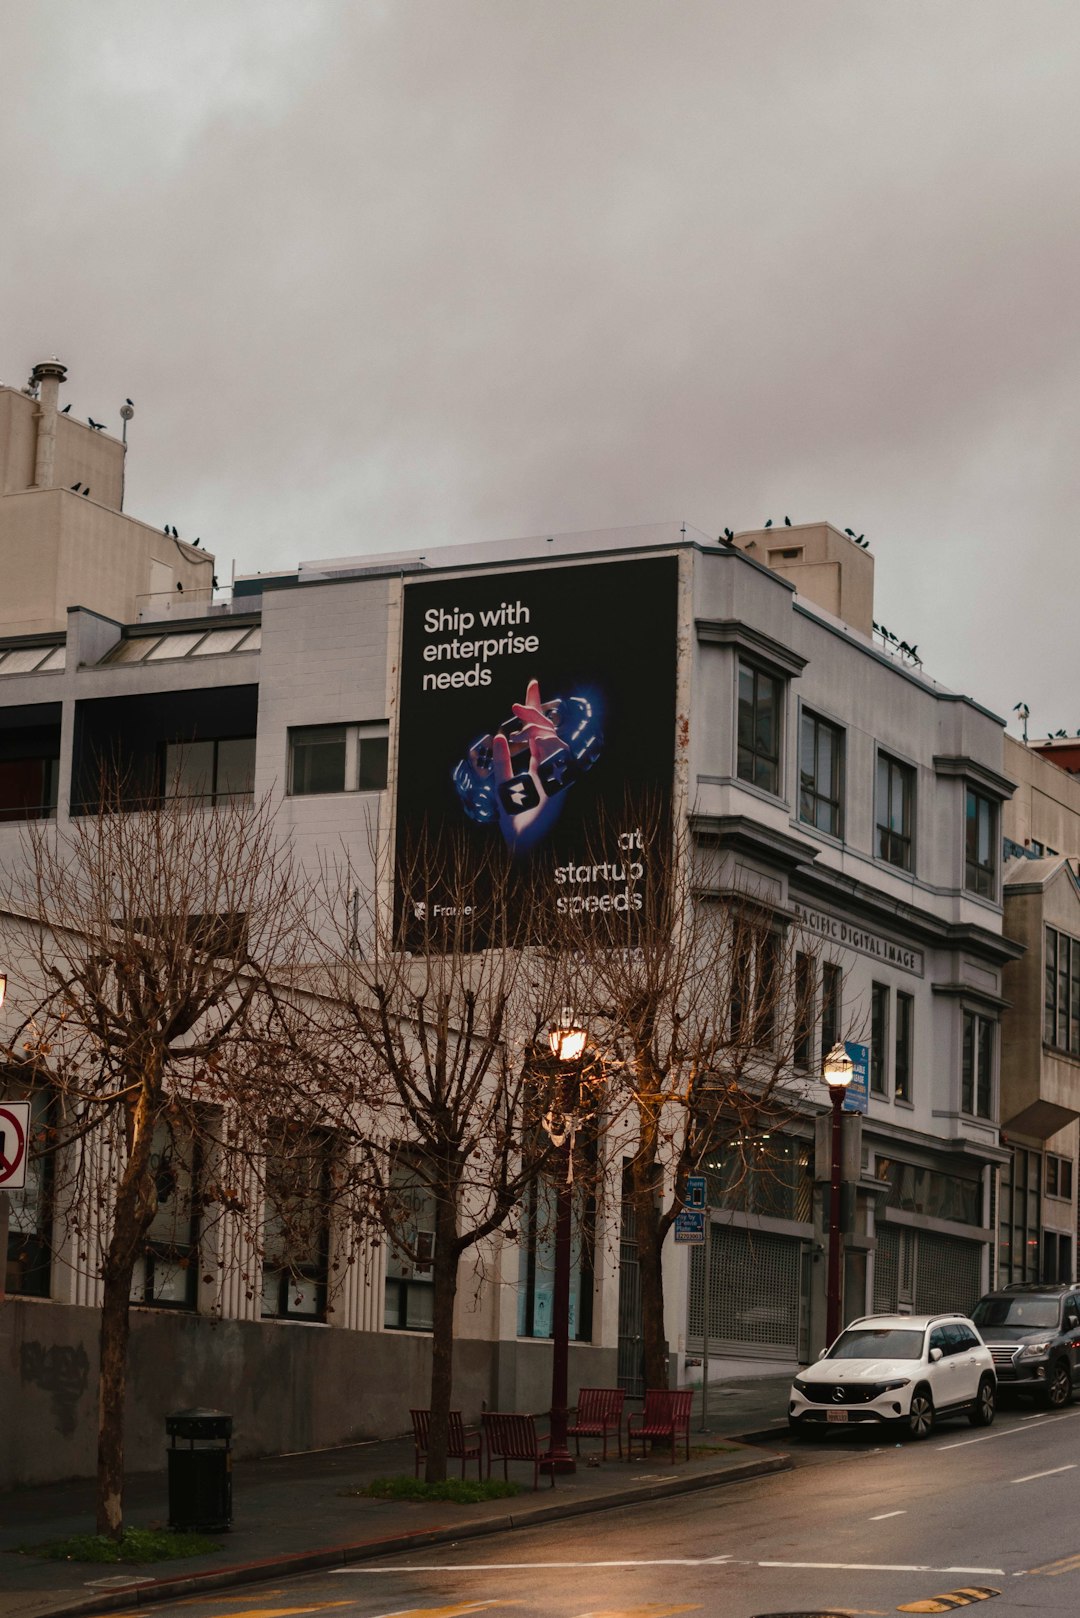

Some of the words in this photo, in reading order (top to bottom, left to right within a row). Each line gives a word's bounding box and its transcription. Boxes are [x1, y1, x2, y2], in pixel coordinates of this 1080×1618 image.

[423, 607, 475, 636] Ship
[479, 601, 530, 627] with
[422, 630, 540, 662] enterprise
[422, 662, 492, 691] needs
[617, 827, 645, 850] at
[554, 861, 643, 885] startup
[555, 886, 643, 914] speeds
[840, 922, 881, 956] DIGITAL
[883, 942, 915, 969] IMAGE
